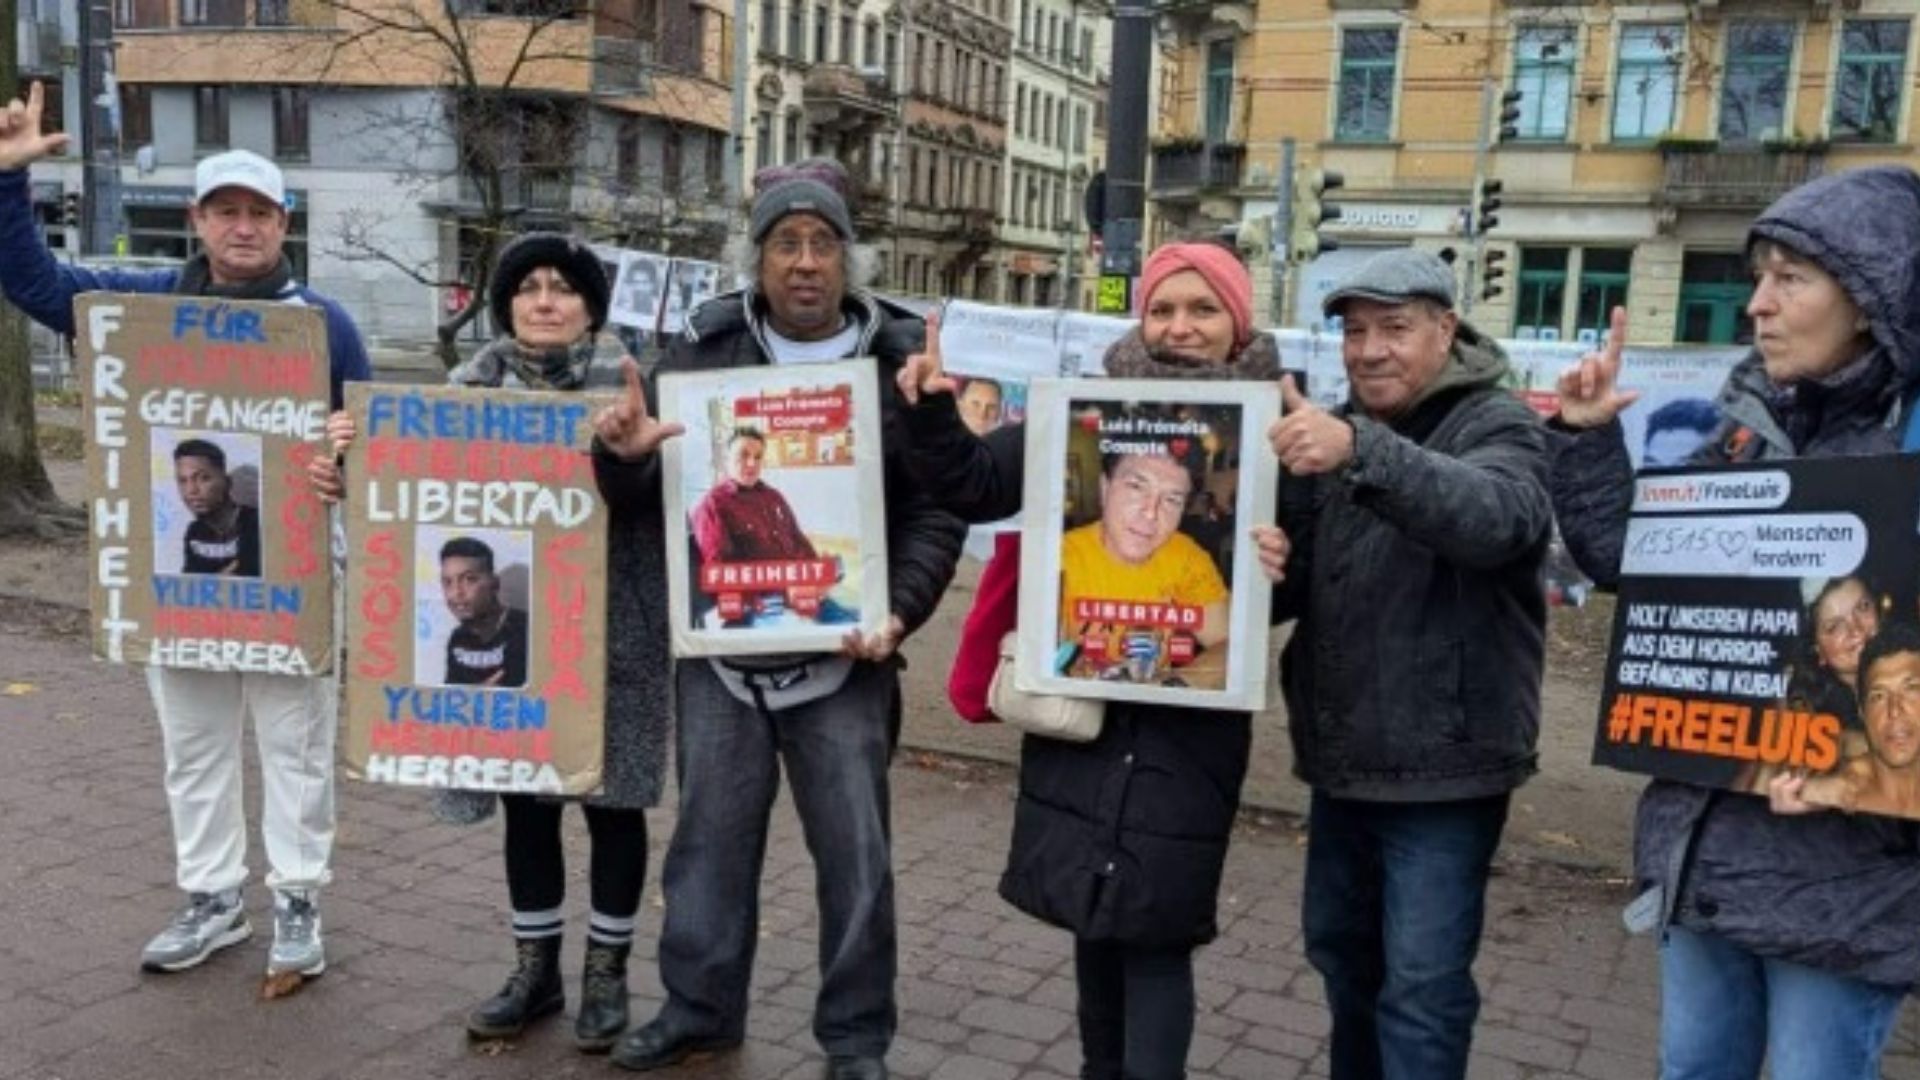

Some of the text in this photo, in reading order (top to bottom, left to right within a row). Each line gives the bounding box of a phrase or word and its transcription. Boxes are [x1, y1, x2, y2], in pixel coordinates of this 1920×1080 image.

[173, 302, 267, 342] FÜR
[140, 388, 327, 441] GEFANGENE
[369, 391, 586, 446] FREIHEIT
[89, 305, 138, 663] FREIHEIT
[368, 479, 594, 527] LIBERTAD
[1756, 523, 1852, 542] Menschen
[707, 563, 825, 585] FREIHEIT
[152, 576, 301, 614] YURIEN
[358, 531, 403, 677] SOS
[1079, 601, 1197, 624] LIBERTAD
[541, 532, 589, 703] CUBA
[1627, 604, 1798, 636] HOLT UNSEREN PAPA
[150, 636, 313, 675] HERRERA
[1622, 632, 1778, 666] AUS DEM HORROR-
[1710, 667, 1730, 693] IN
[384, 685, 547, 731] YURIEN
[1609, 692, 1842, 773] #FREELUIS
[366, 753, 563, 794] HERRERA
